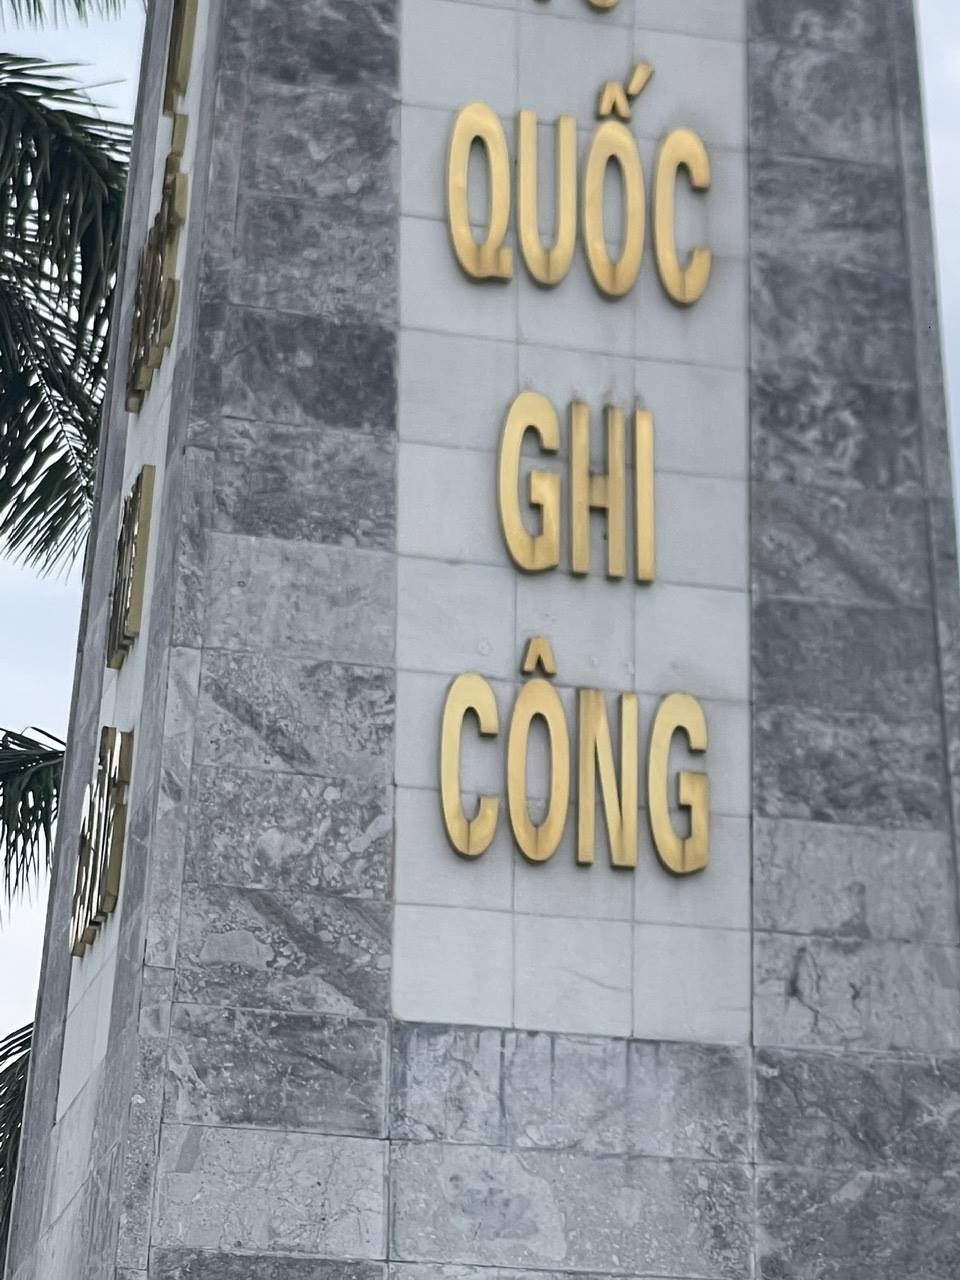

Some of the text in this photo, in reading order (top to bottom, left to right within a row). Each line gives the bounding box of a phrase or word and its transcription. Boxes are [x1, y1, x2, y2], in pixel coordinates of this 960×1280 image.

[447, 62, 712, 308] QUỐC
[499, 390, 655, 585] GHI
[439, 634, 711, 876] CÔNG
